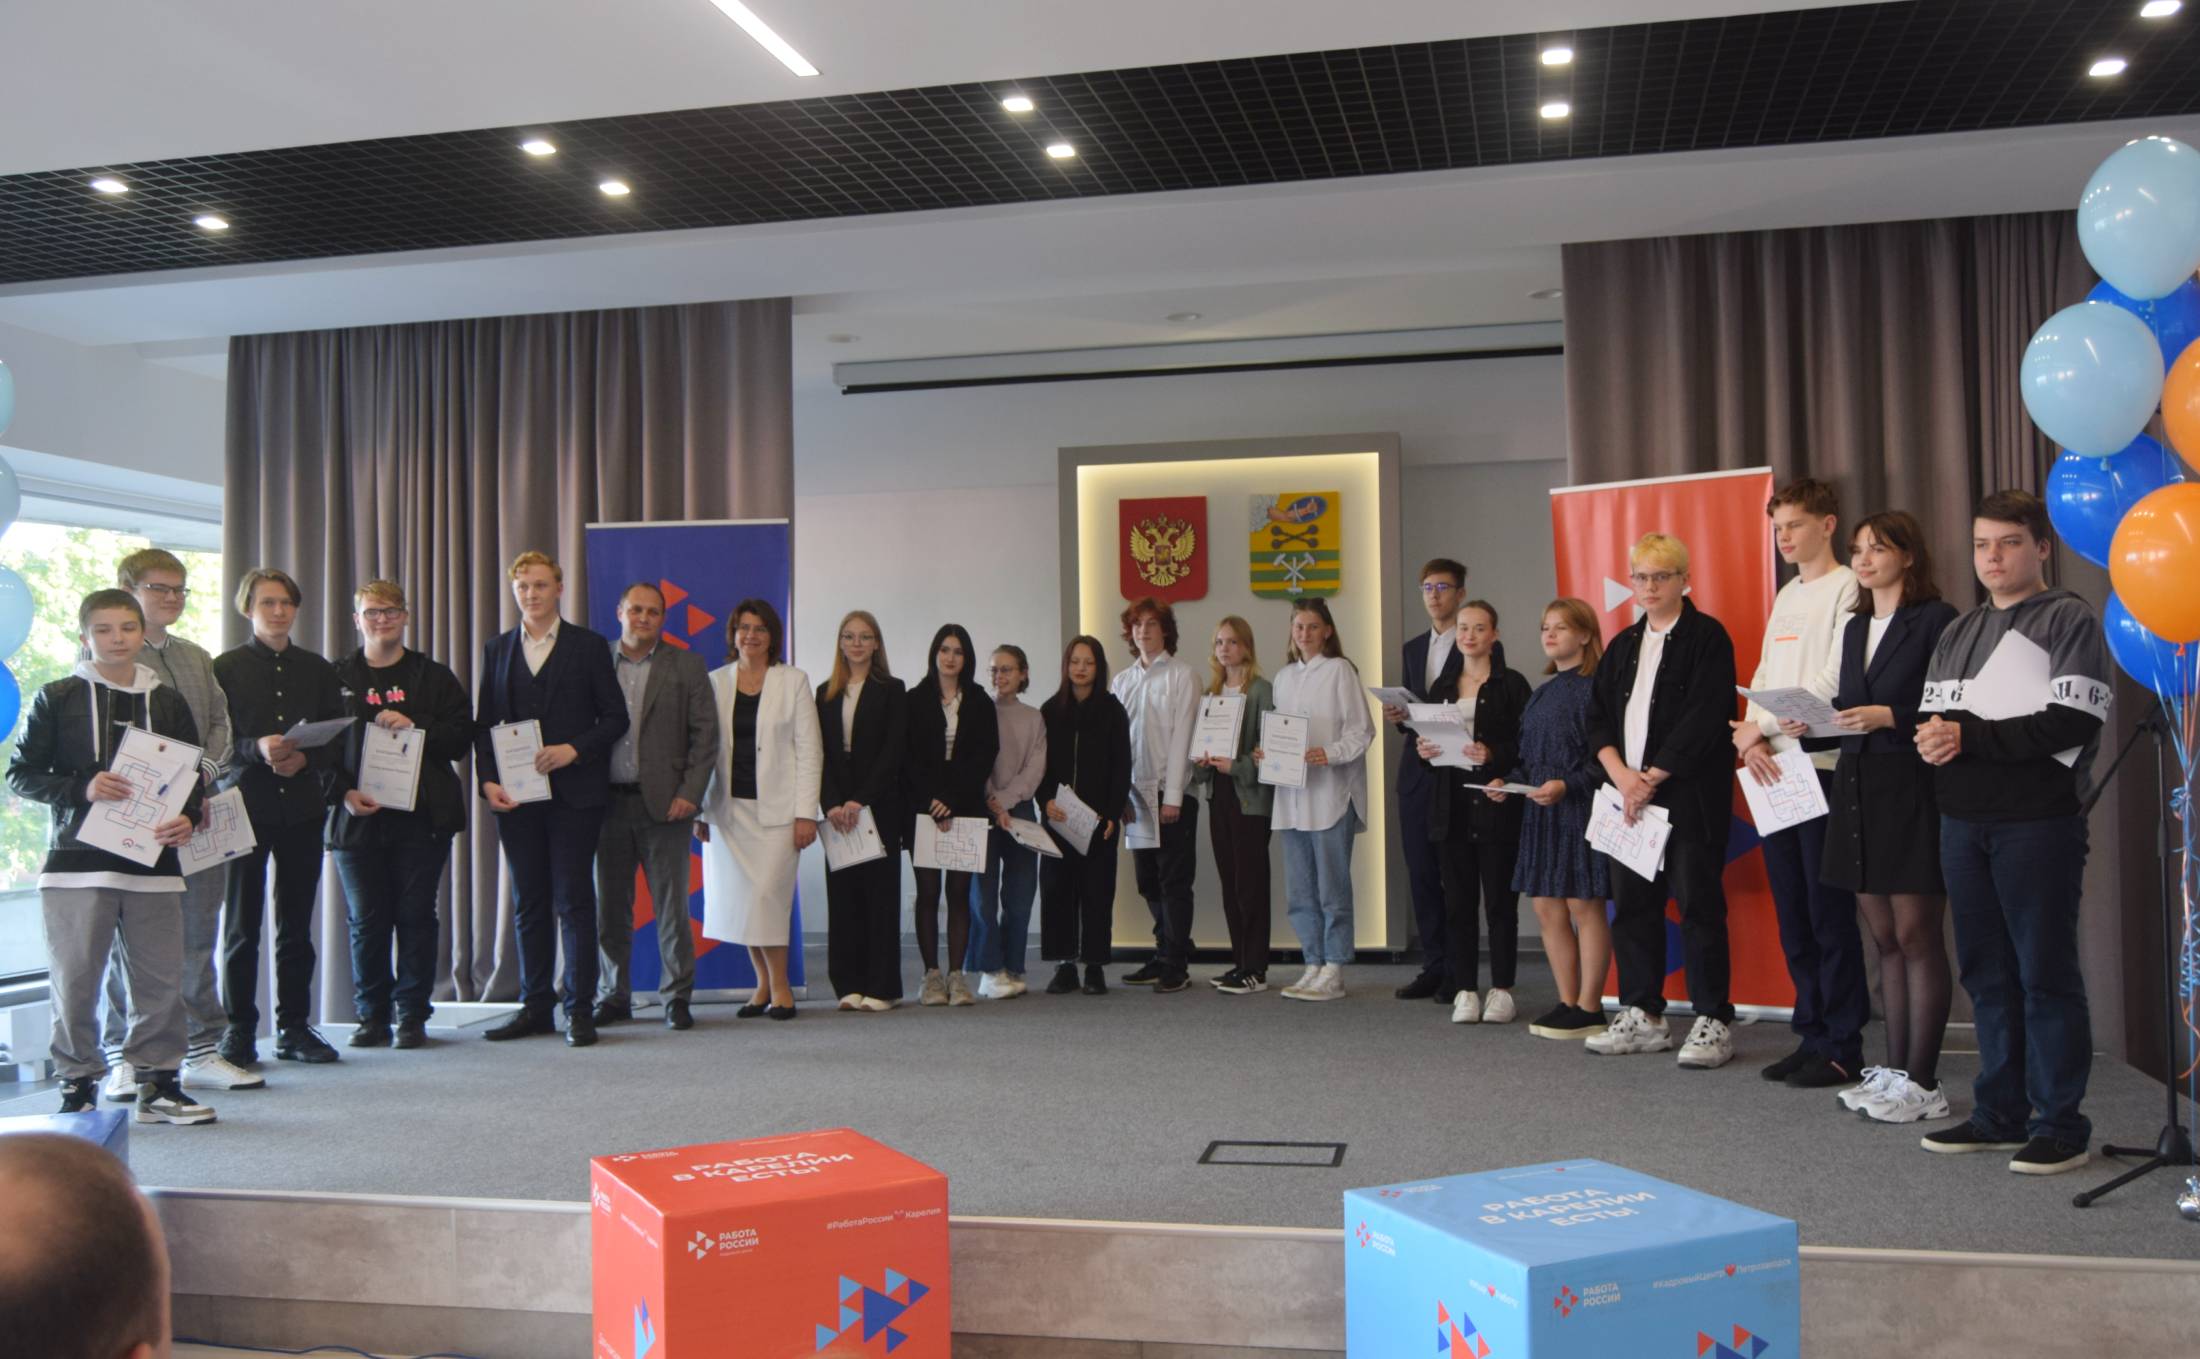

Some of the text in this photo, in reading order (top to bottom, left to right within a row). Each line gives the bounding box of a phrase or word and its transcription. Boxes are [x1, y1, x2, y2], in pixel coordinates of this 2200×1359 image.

[672, 1153, 854, 1182] В КАРЕЛИИ
[691, 1151, 818, 1171] РАБОТА
[1478, 1191, 1657, 1225] В КАРЕЛИИ
[1482, 1188, 1610, 1212] РАБОТА
[1548, 1207, 1641, 1226] ЕСТЬ!
[719, 1228, 758, 1241] РАБОТА
[719, 1237, 760, 1250] РОССИИ
[1583, 1282, 1620, 1297] РАБОТА
[1583, 1291, 1621, 1308] РОССИИ
